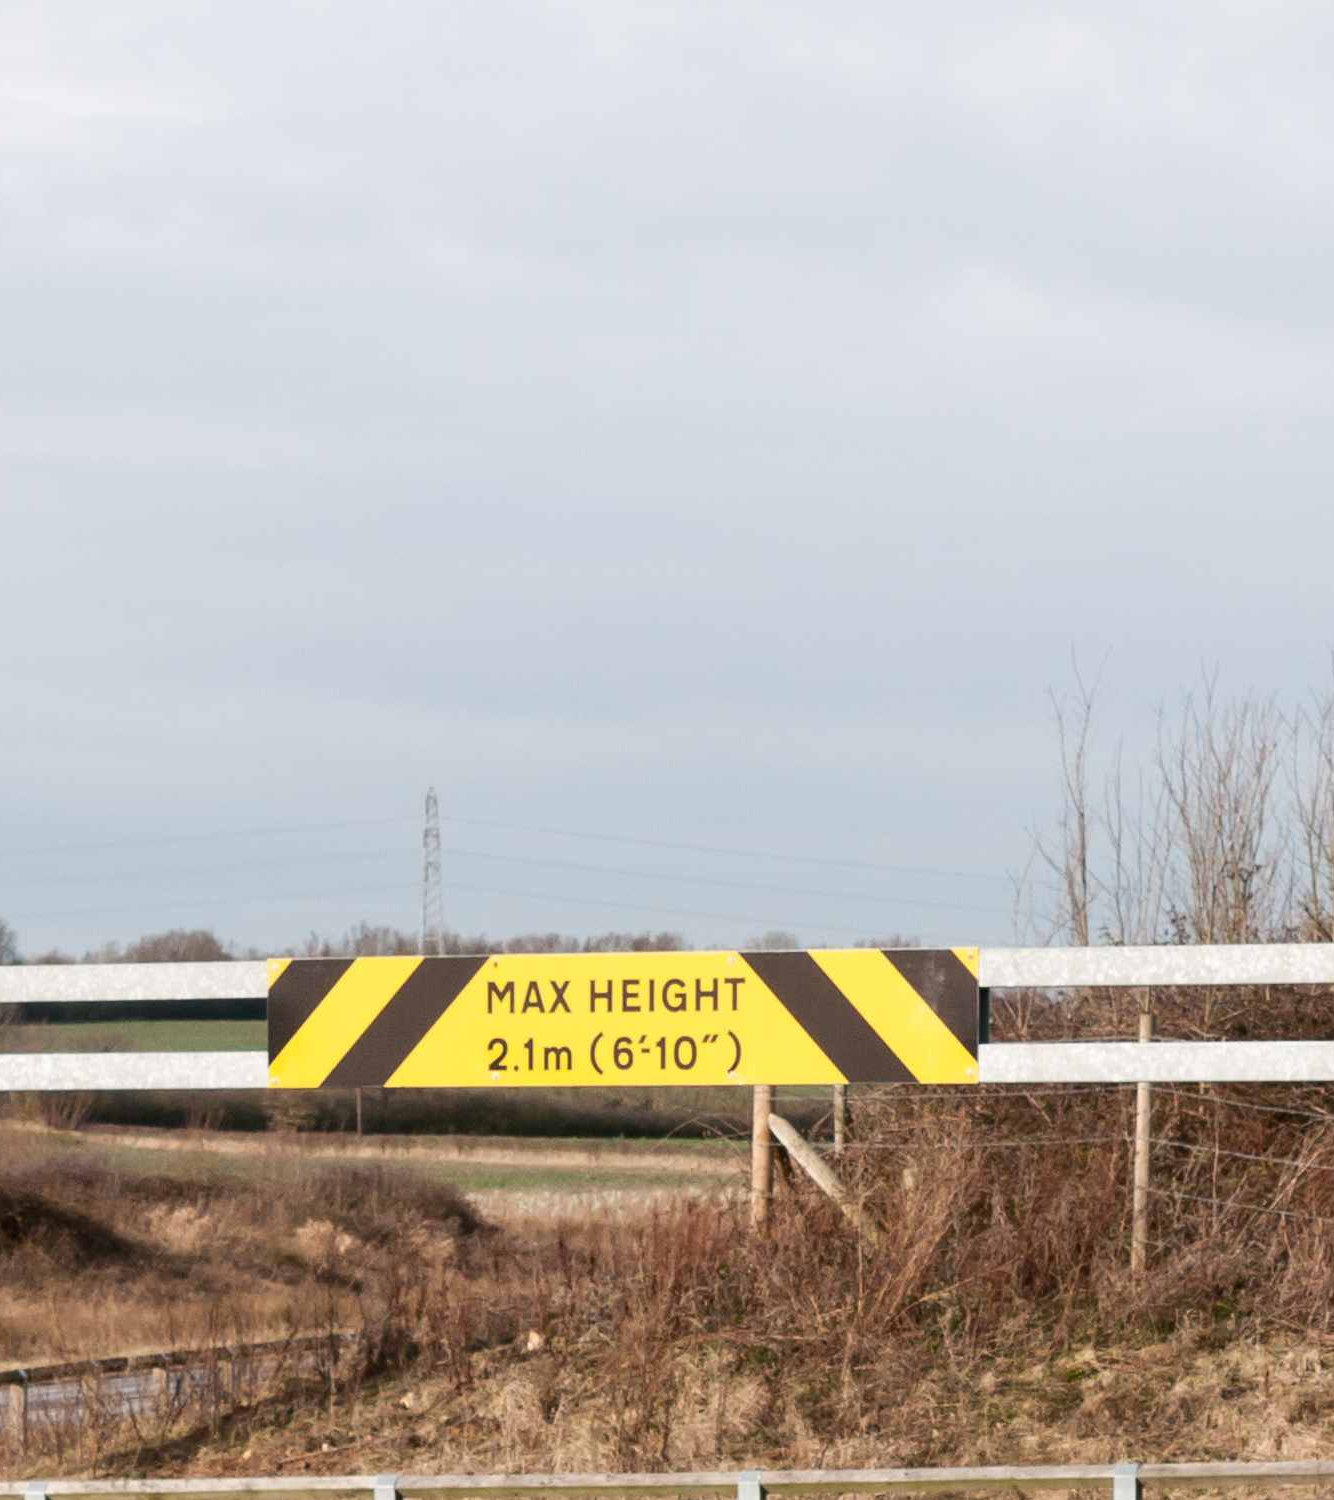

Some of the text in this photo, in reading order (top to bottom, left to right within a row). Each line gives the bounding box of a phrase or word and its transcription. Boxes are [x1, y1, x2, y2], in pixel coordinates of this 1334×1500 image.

[486, 977, 746, 1014] MAX HEIGHT
[486, 1037, 573, 1071] 2.1m
